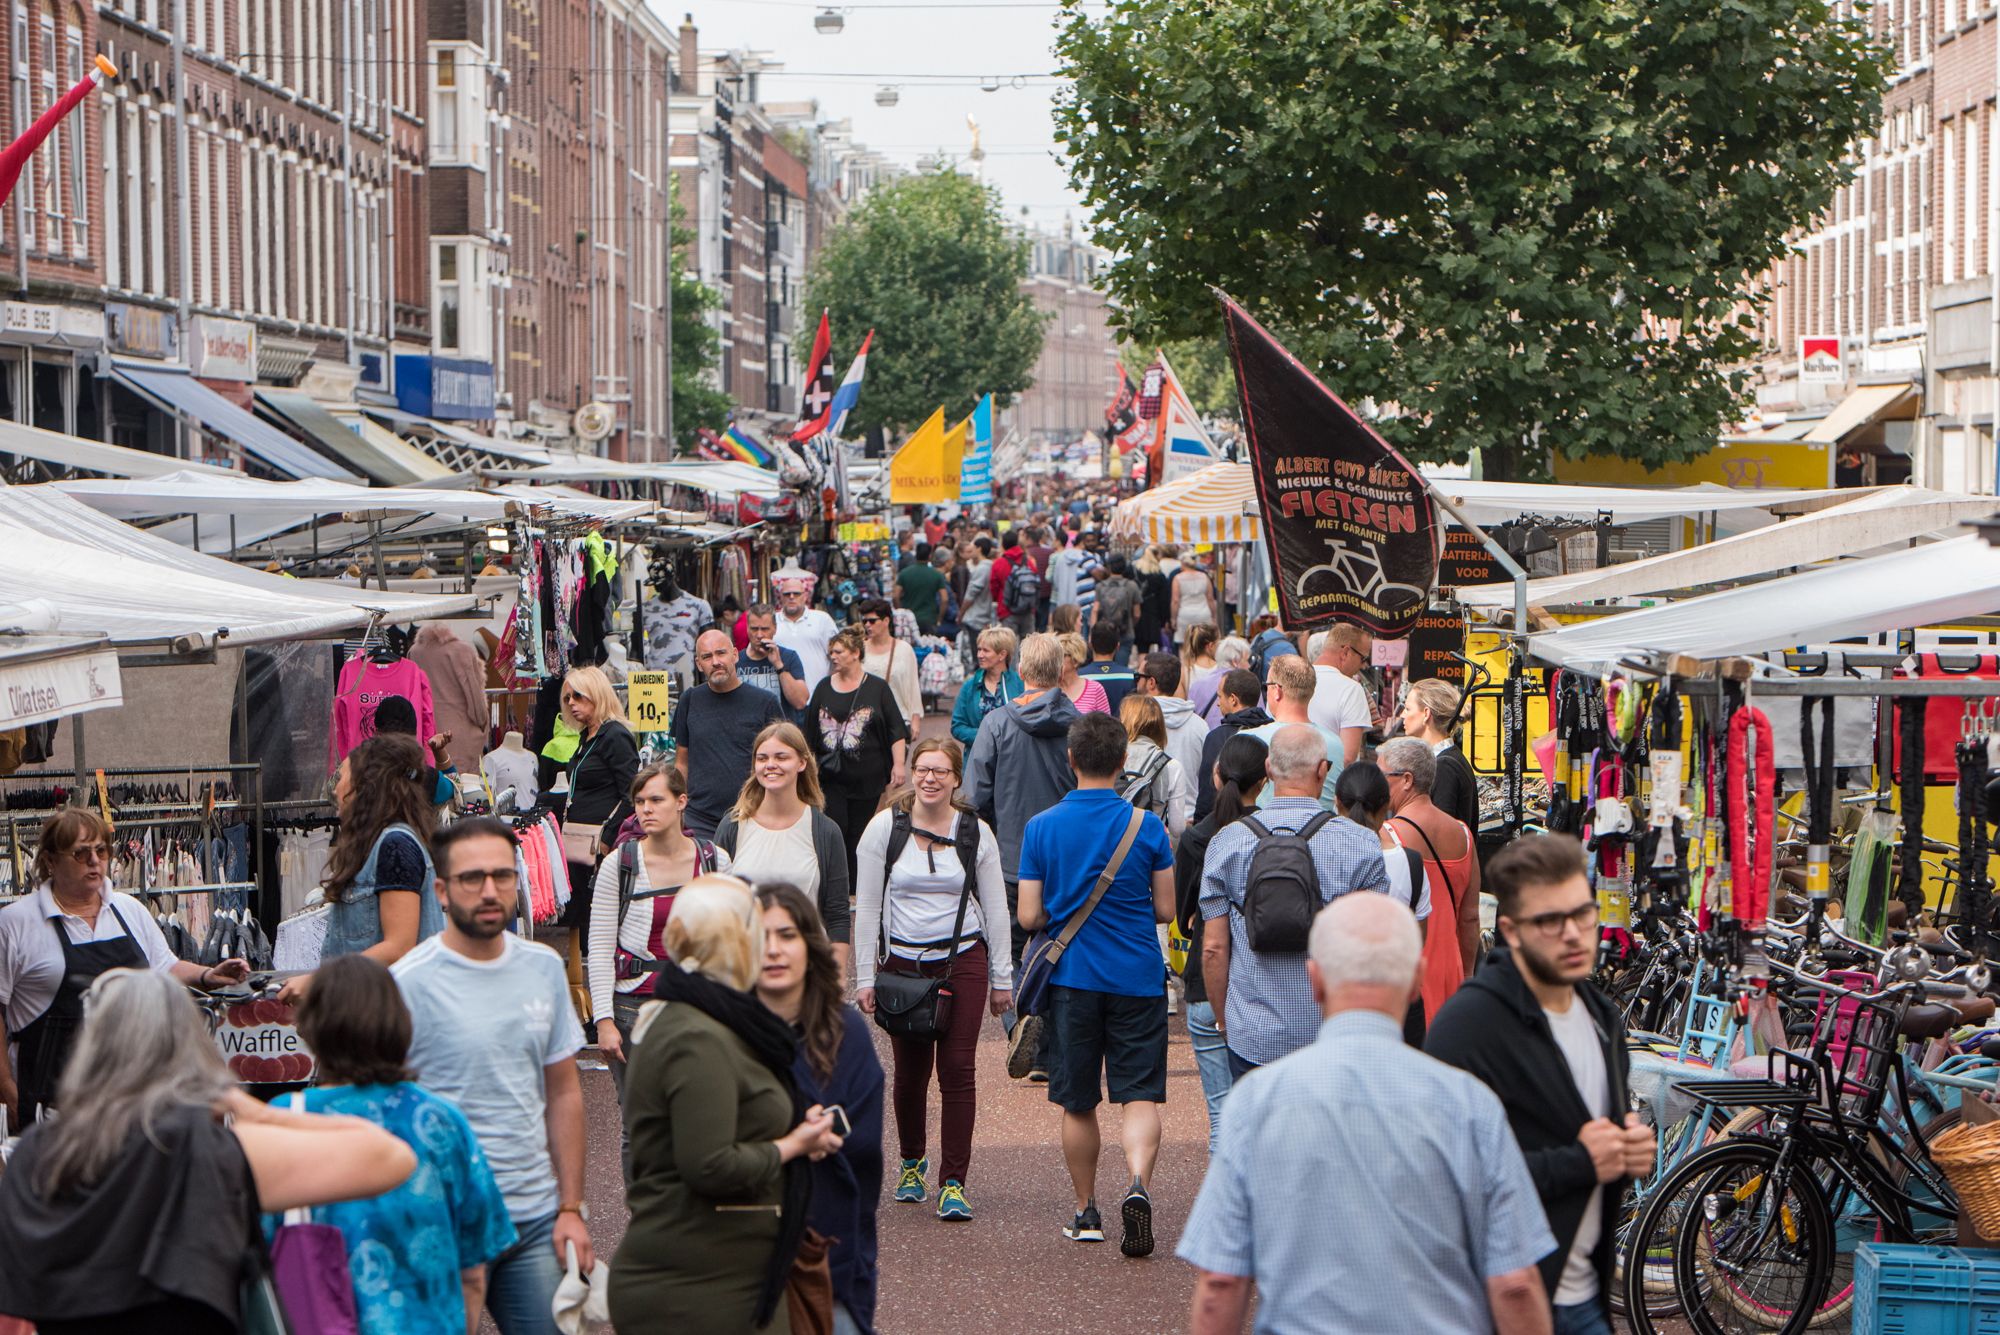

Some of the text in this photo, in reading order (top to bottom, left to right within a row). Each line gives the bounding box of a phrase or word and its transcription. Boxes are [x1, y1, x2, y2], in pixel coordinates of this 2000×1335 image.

[7, 308, 51, 329] PLUS SIZE
[895, 476, 940, 488] MIKADO
[1275, 456, 1410, 488] ALBERT CUYP BIKES
[1277, 476, 1413, 502] NIEUWE & GEBRUIKTE
[1280, 489, 1417, 534] FIETSEN
[1315, 519, 1387, 545] MET GARANTIE
[1441, 550, 1496, 561] BATTERIJE
[1455, 567, 1489, 578] VOOR
[1299, 593, 1360, 610] REPARATIES
[1360, 602, 1390, 620] BINNEN
[1394, 611, 1400, 620] 1
[633, 673, 665, 685] AANBIEDING
[220, 1029, 297, 1053] Waffle
[1852, 1179, 1873, 1201] POPAL
[1923, 1174, 1944, 1196] POPAL
